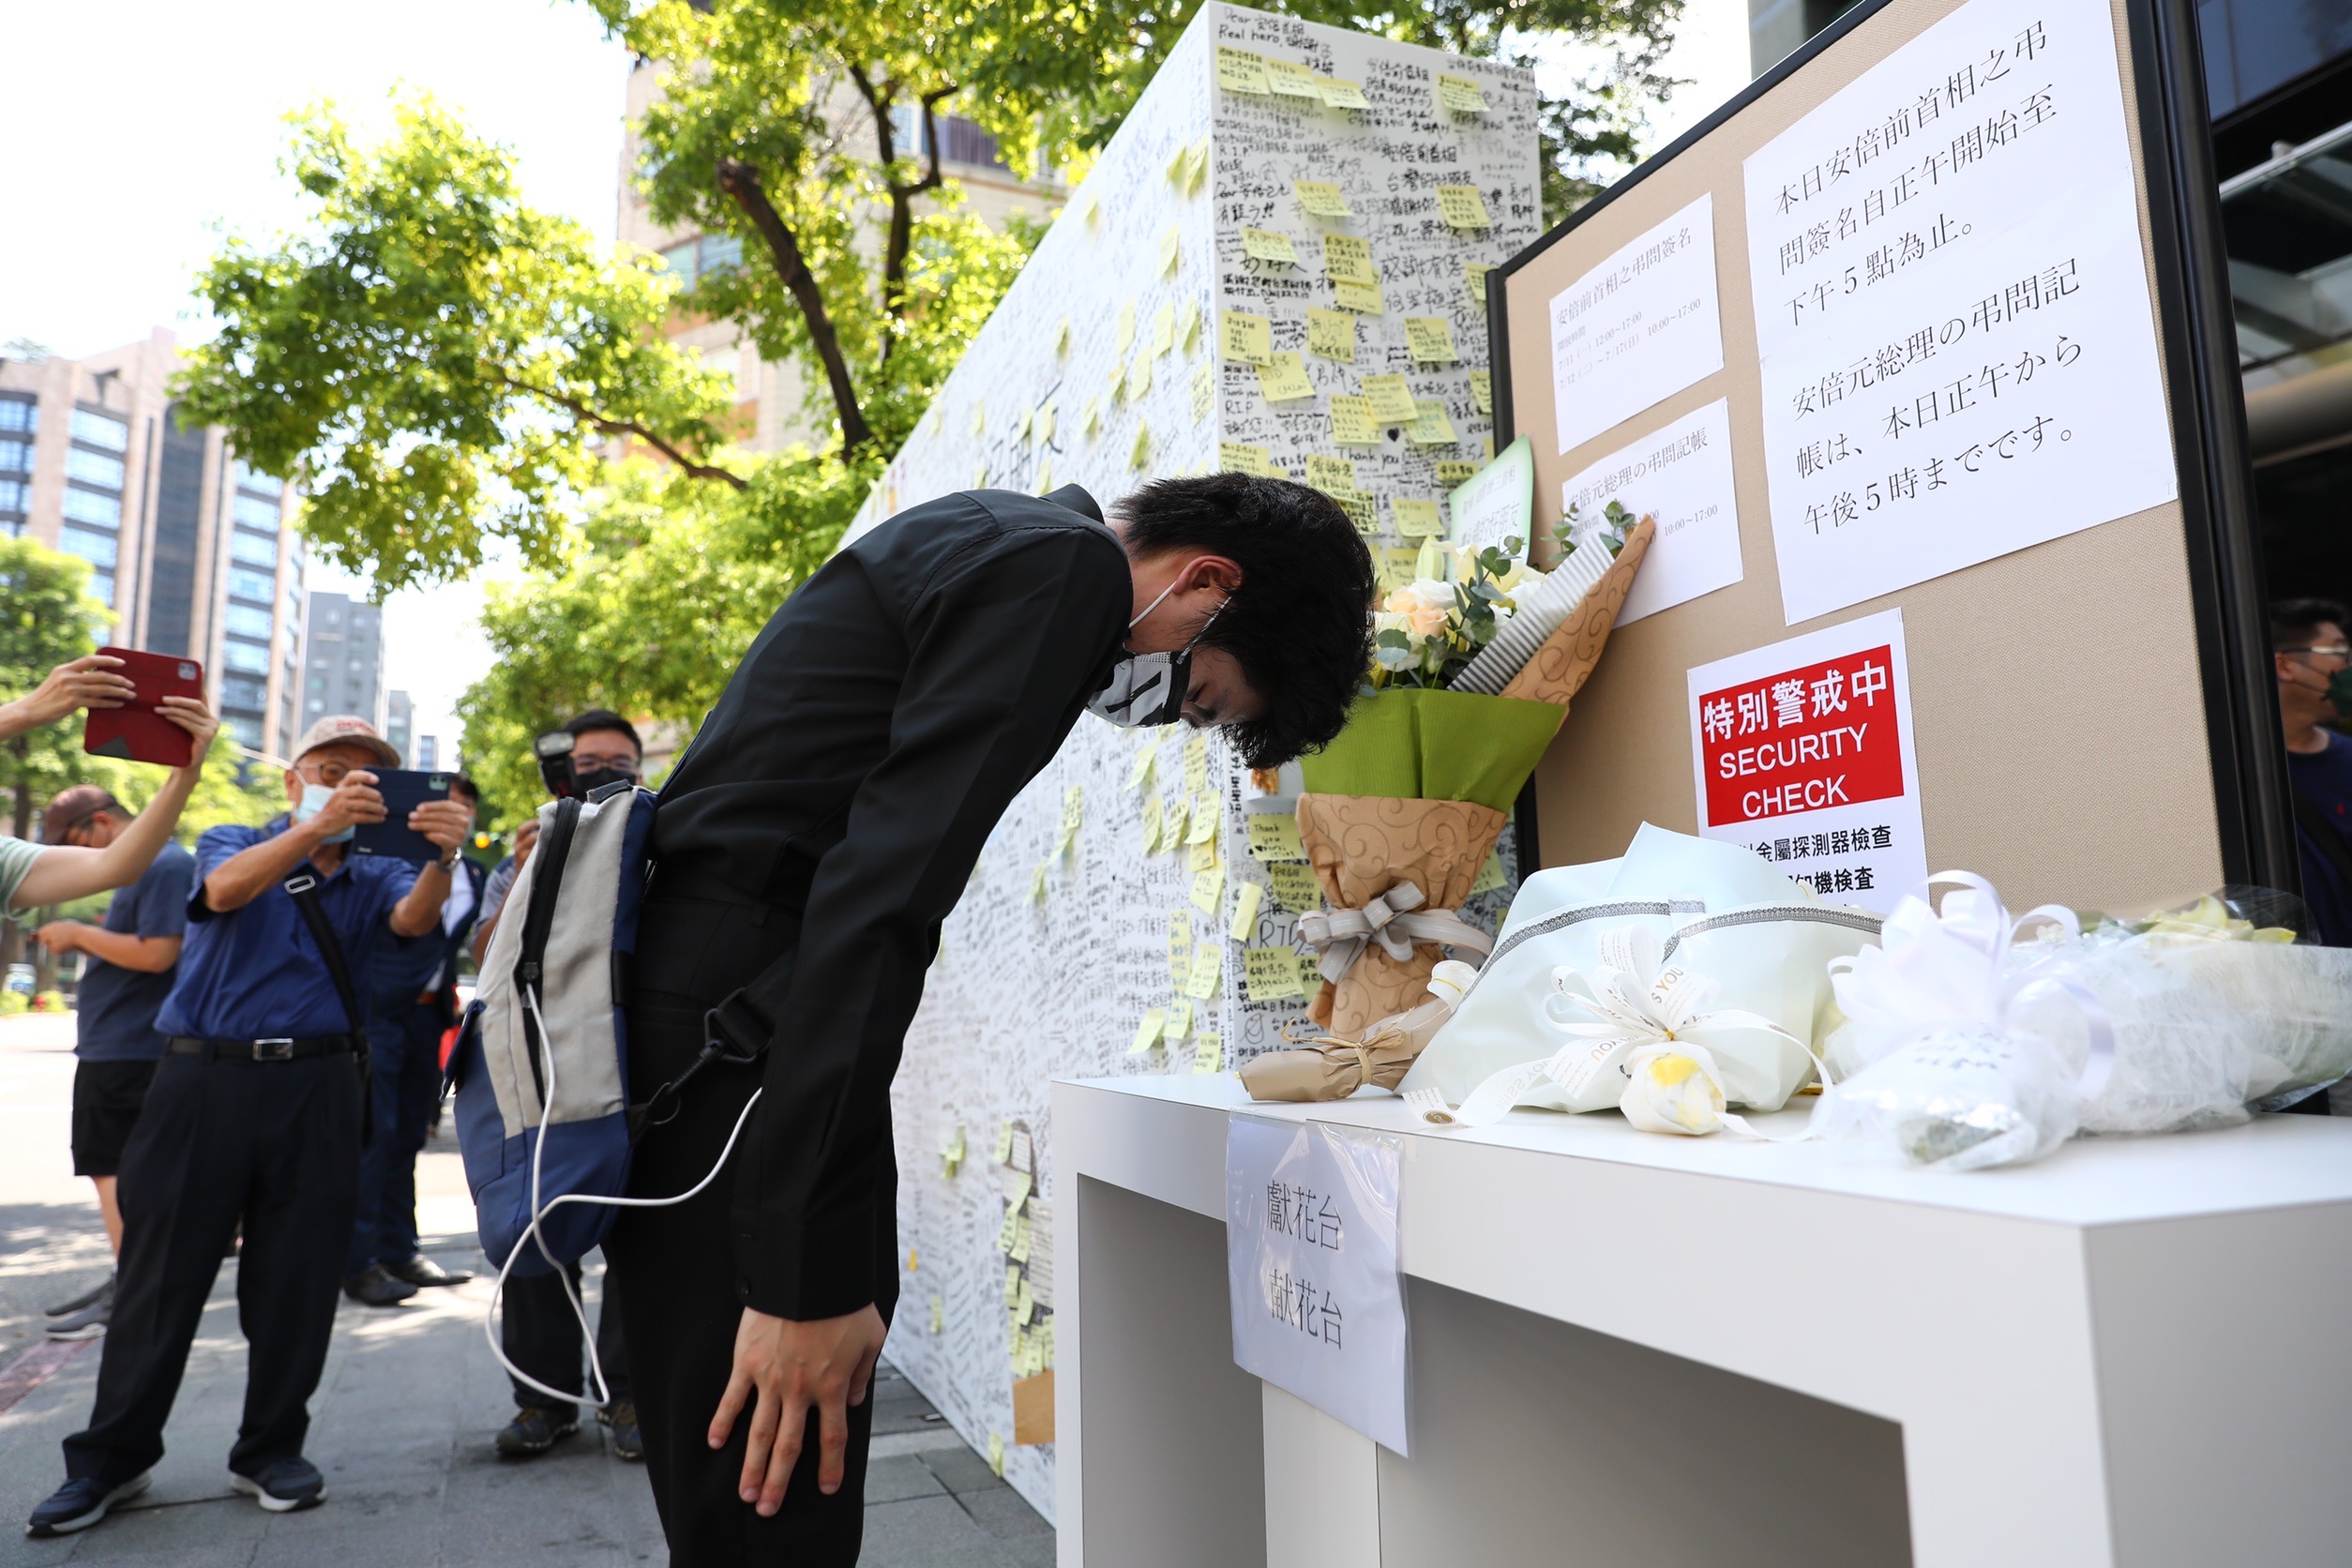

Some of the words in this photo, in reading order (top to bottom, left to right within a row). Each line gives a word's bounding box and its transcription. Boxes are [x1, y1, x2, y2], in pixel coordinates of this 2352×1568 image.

[1775, 21, 2046, 216] 本日安倍前首相之弔
[1780, 83, 2057, 276] 問簽名自正午開始至
[1557, 227, 1692, 326] 安倍前首相之弔問簽名
[1784, 213, 1971, 326] 下午5點為止。
[1648, 298, 1701, 337] 10:00~17:00
[1793, 258, 2080, 422] 安倍元総理の弔問記
[1225, 400, 1254, 415] RIP
[1797, 335, 2081, 479] 帳は、本日正午から
[1334, 446, 1377, 464] Thank
[1381, 453, 1399, 470] you
[1804, 416, 2072, 535] 午後5時までです。
[1664, 505, 1718, 536] 10:00~17:00
[1703, 659, 1888, 743] 特別警戒中
[1719, 723, 1868, 779] SECURITY
[1741, 775, 1849, 819] CHECK
[1266, 1180, 1343, 1252] 獻花台
[1269, 1268, 1342, 1350] 献花台
